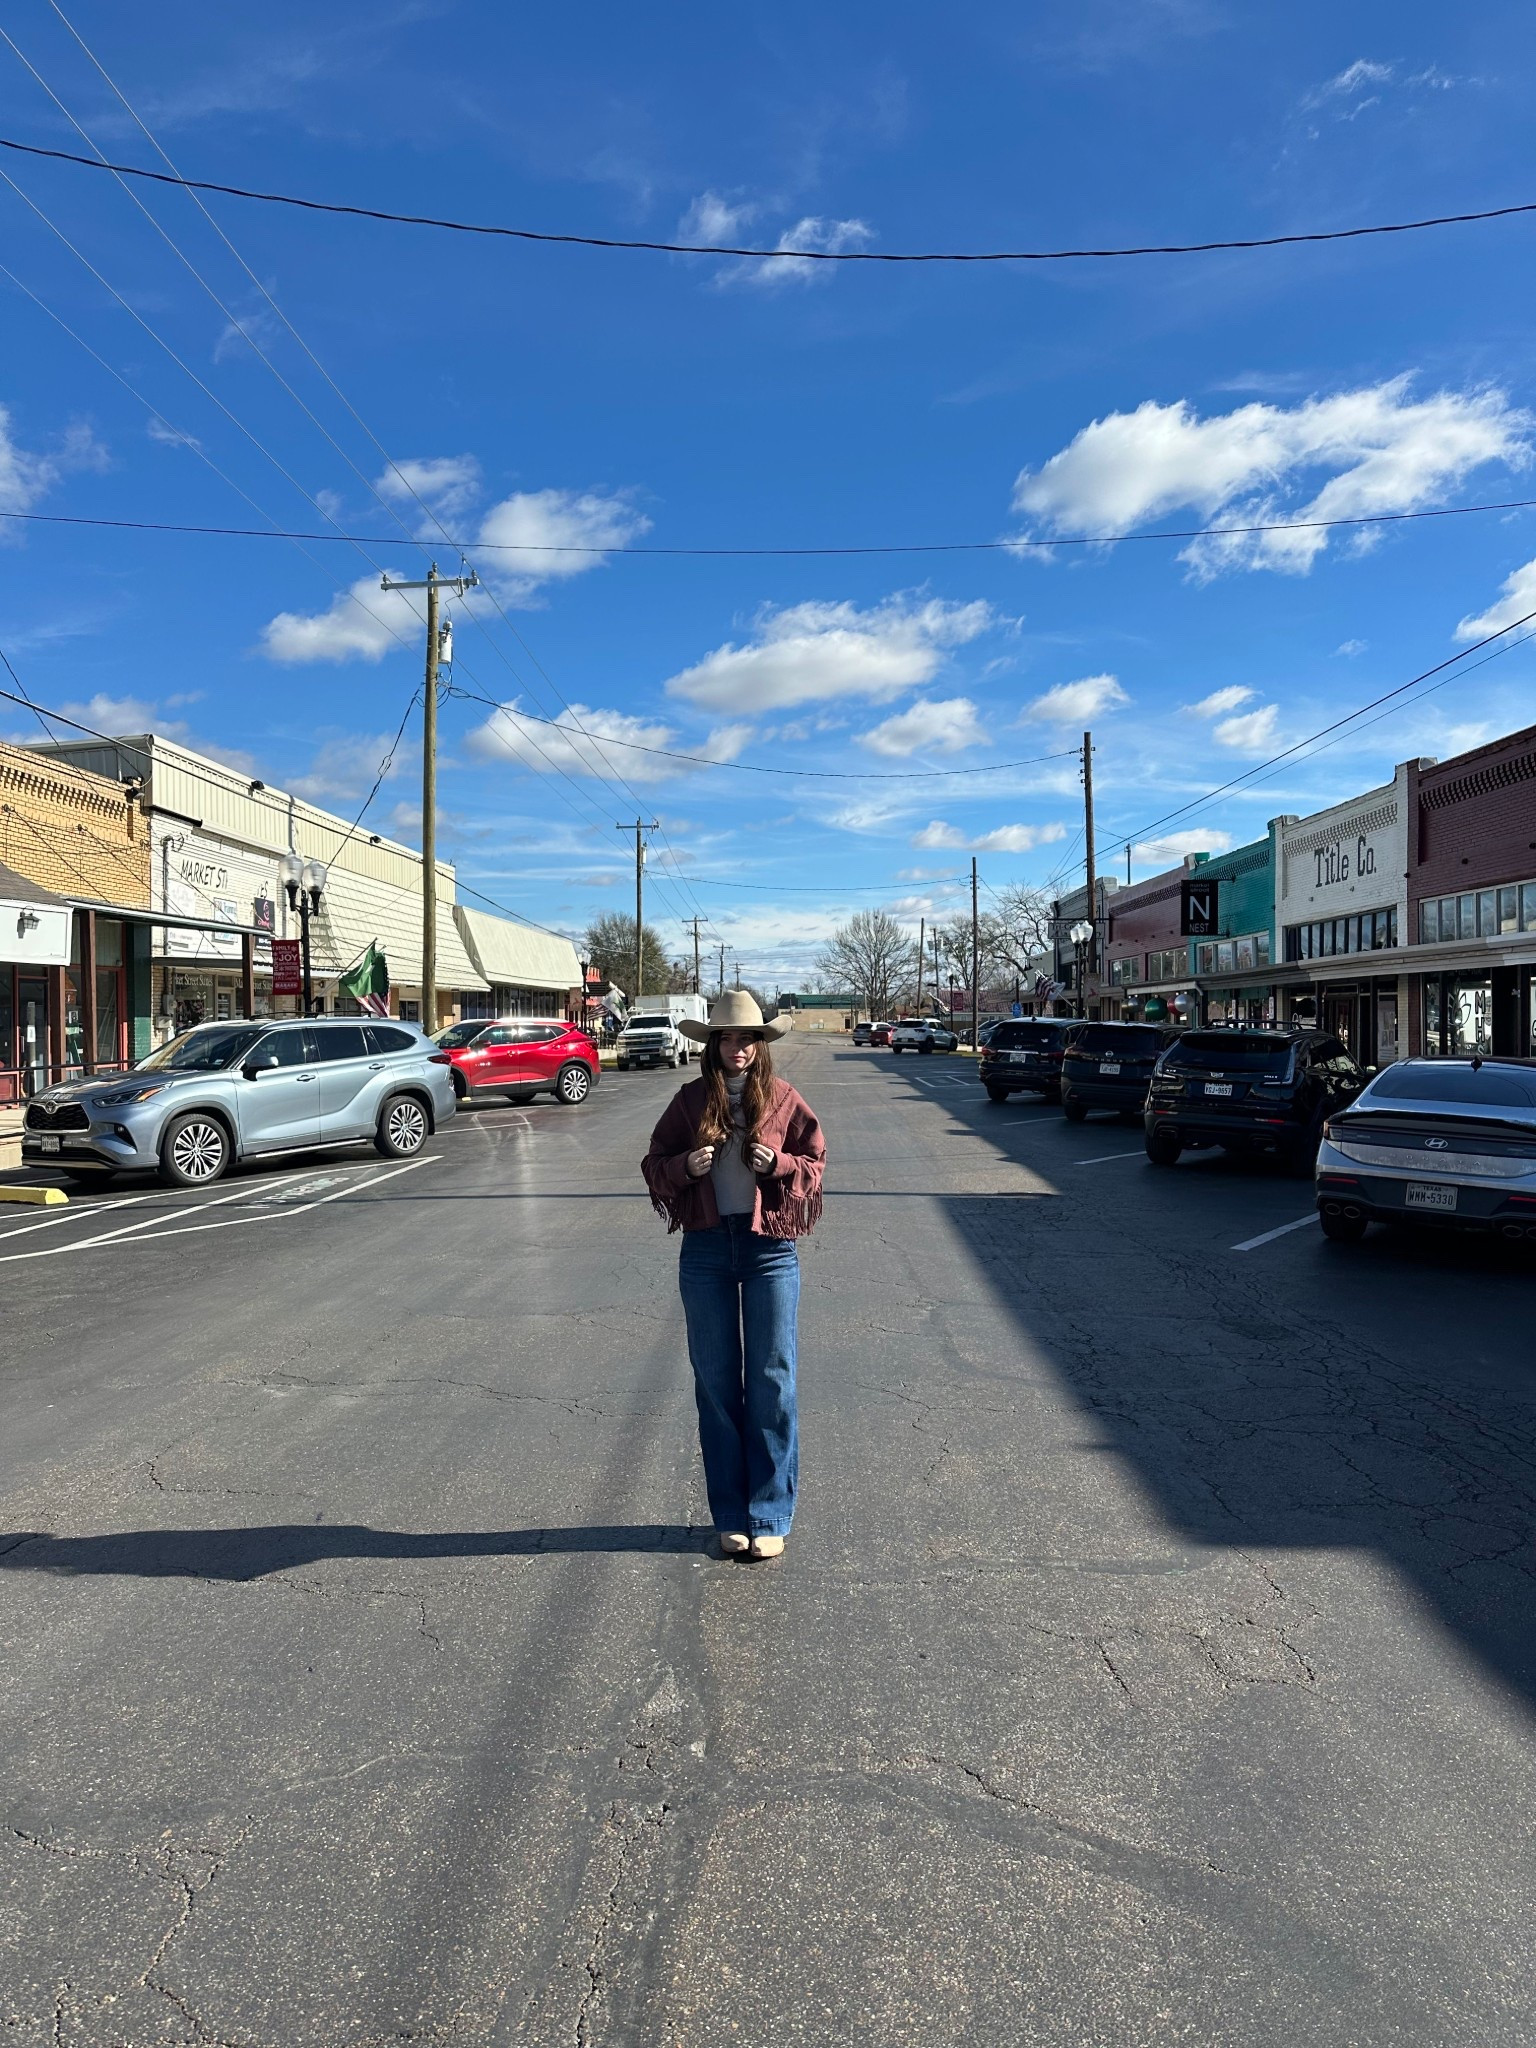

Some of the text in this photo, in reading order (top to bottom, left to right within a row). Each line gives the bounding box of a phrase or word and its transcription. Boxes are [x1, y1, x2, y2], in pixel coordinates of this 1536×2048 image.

[181, 859, 216, 886] MARKET
[1314, 835, 1377, 888] Title Co.
[1189, 895, 1210, 920] N
[1189, 922, 1209, 933] NEST
[279, 953, 298, 962] JOY
